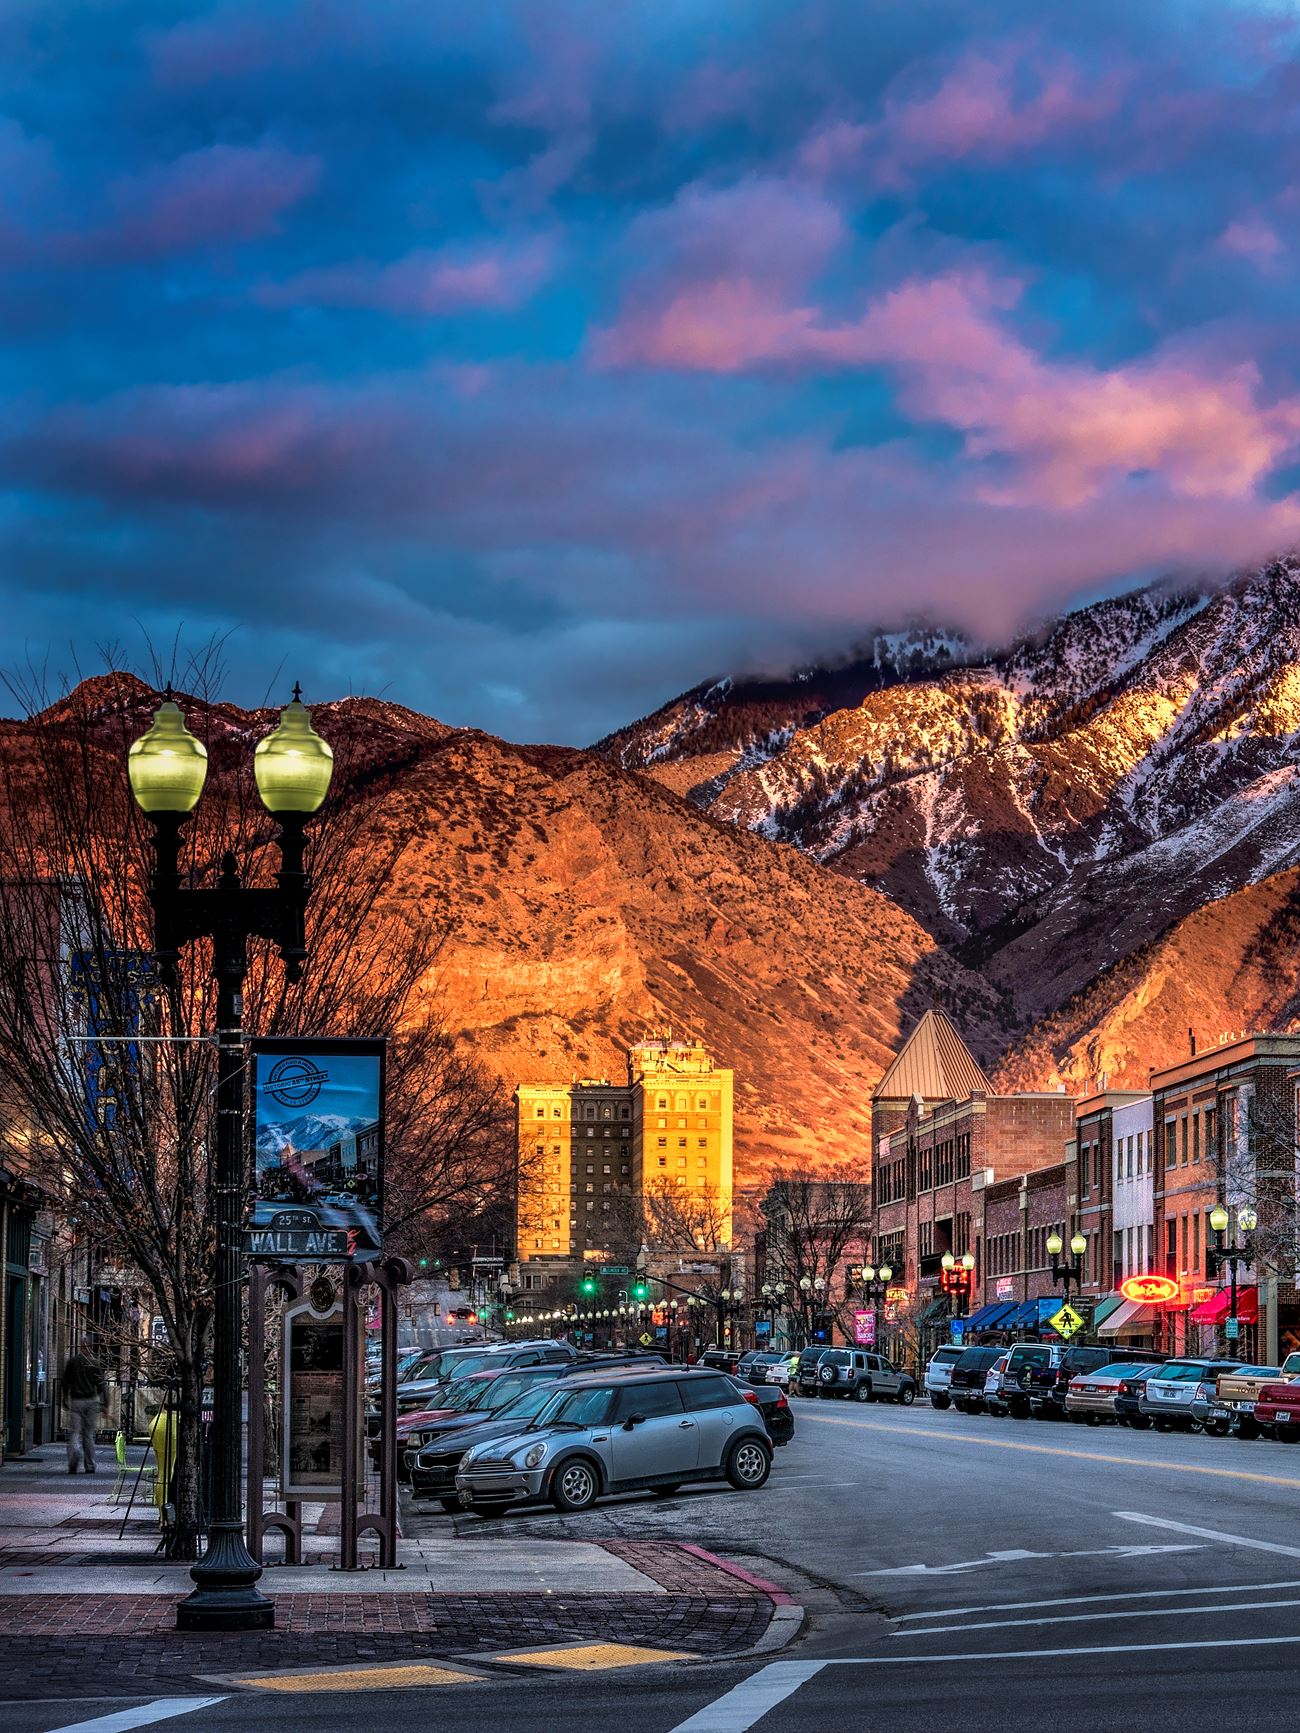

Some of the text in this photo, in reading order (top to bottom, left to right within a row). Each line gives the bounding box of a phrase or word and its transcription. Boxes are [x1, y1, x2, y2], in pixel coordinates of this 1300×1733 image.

[263, 1081, 292, 1092] HISTORIC
[304, 1073, 329, 1084] STREET
[279, 1215, 312, 1226] 25TH ST.
[250, 1232, 299, 1253] WALL
[305, 1232, 342, 1253] AVE.
[1236, 1386, 1260, 1394] TOYOT
